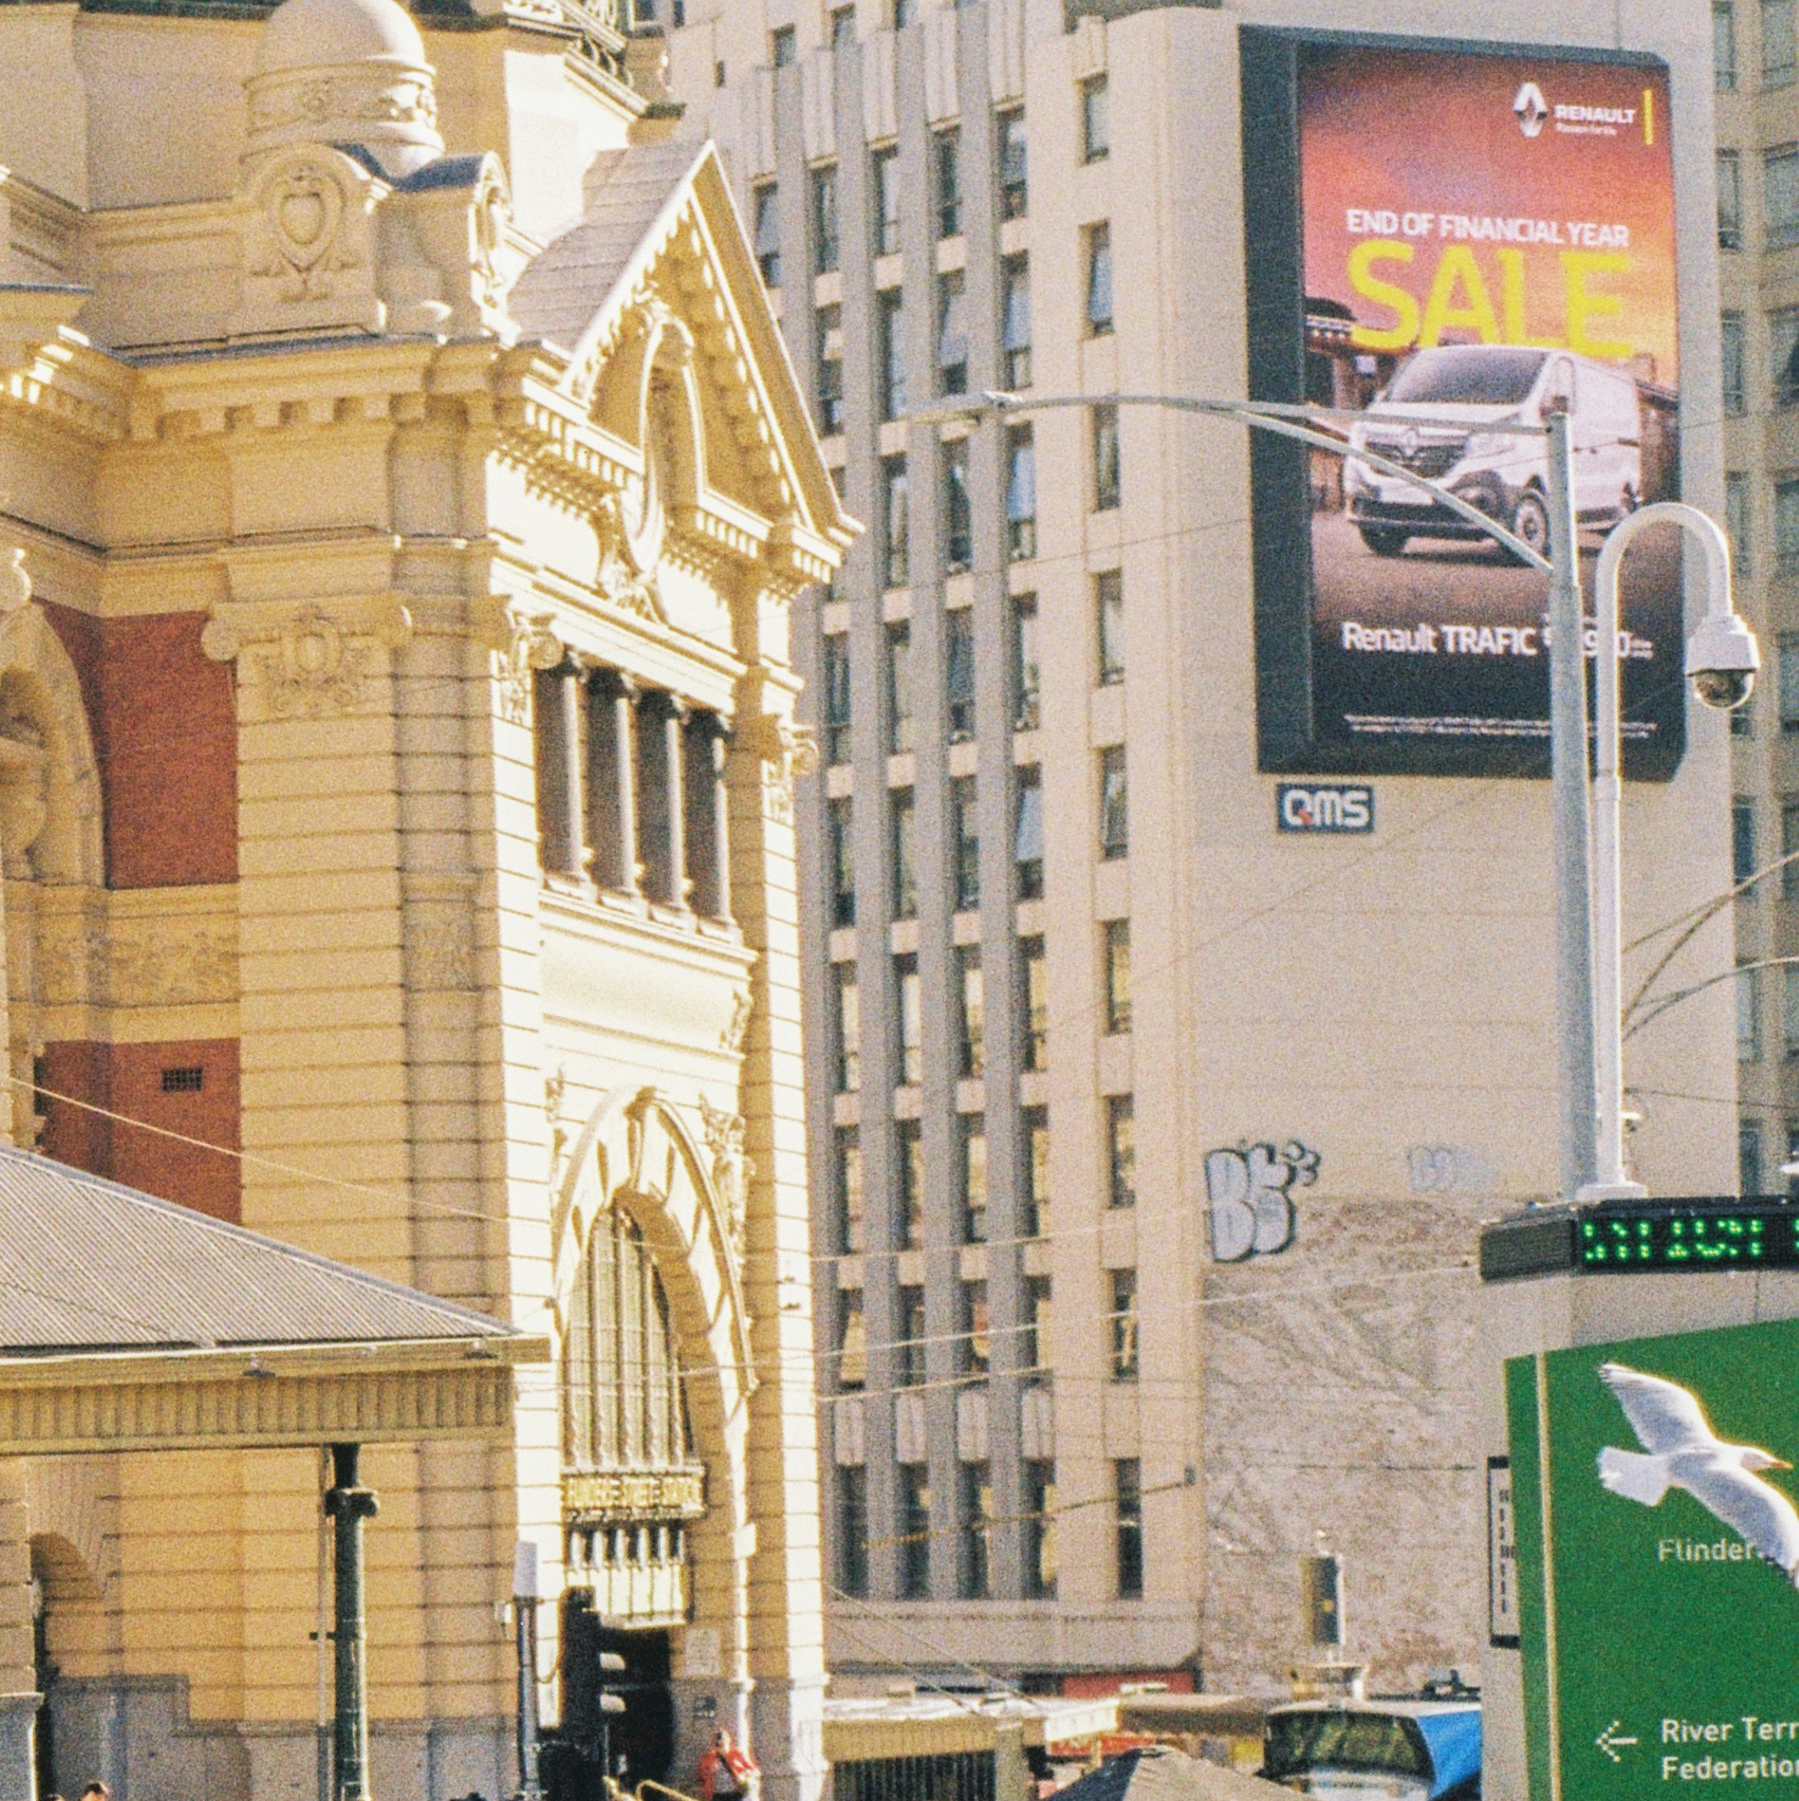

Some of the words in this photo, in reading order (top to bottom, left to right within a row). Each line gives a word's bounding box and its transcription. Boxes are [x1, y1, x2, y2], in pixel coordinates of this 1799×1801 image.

[1554, 104, 1636, 124] RENAULT
[1346, 209, 1398, 235] END
[1402, 212, 1435, 237] OF
[1439, 214, 1565, 245] FINANCIAL
[1567, 220, 1630, 248] YEAR
[1348, 238, 1632, 359] SALE
[1342, 621, 1437, 653] Renault
[1439, 624, 1538, 656] TRAFIC
[1284, 789, 1370, 827] QMS
[1662, 1718, 1734, 1743] River
[1662, 1753, 1799, 1780] Federatio
